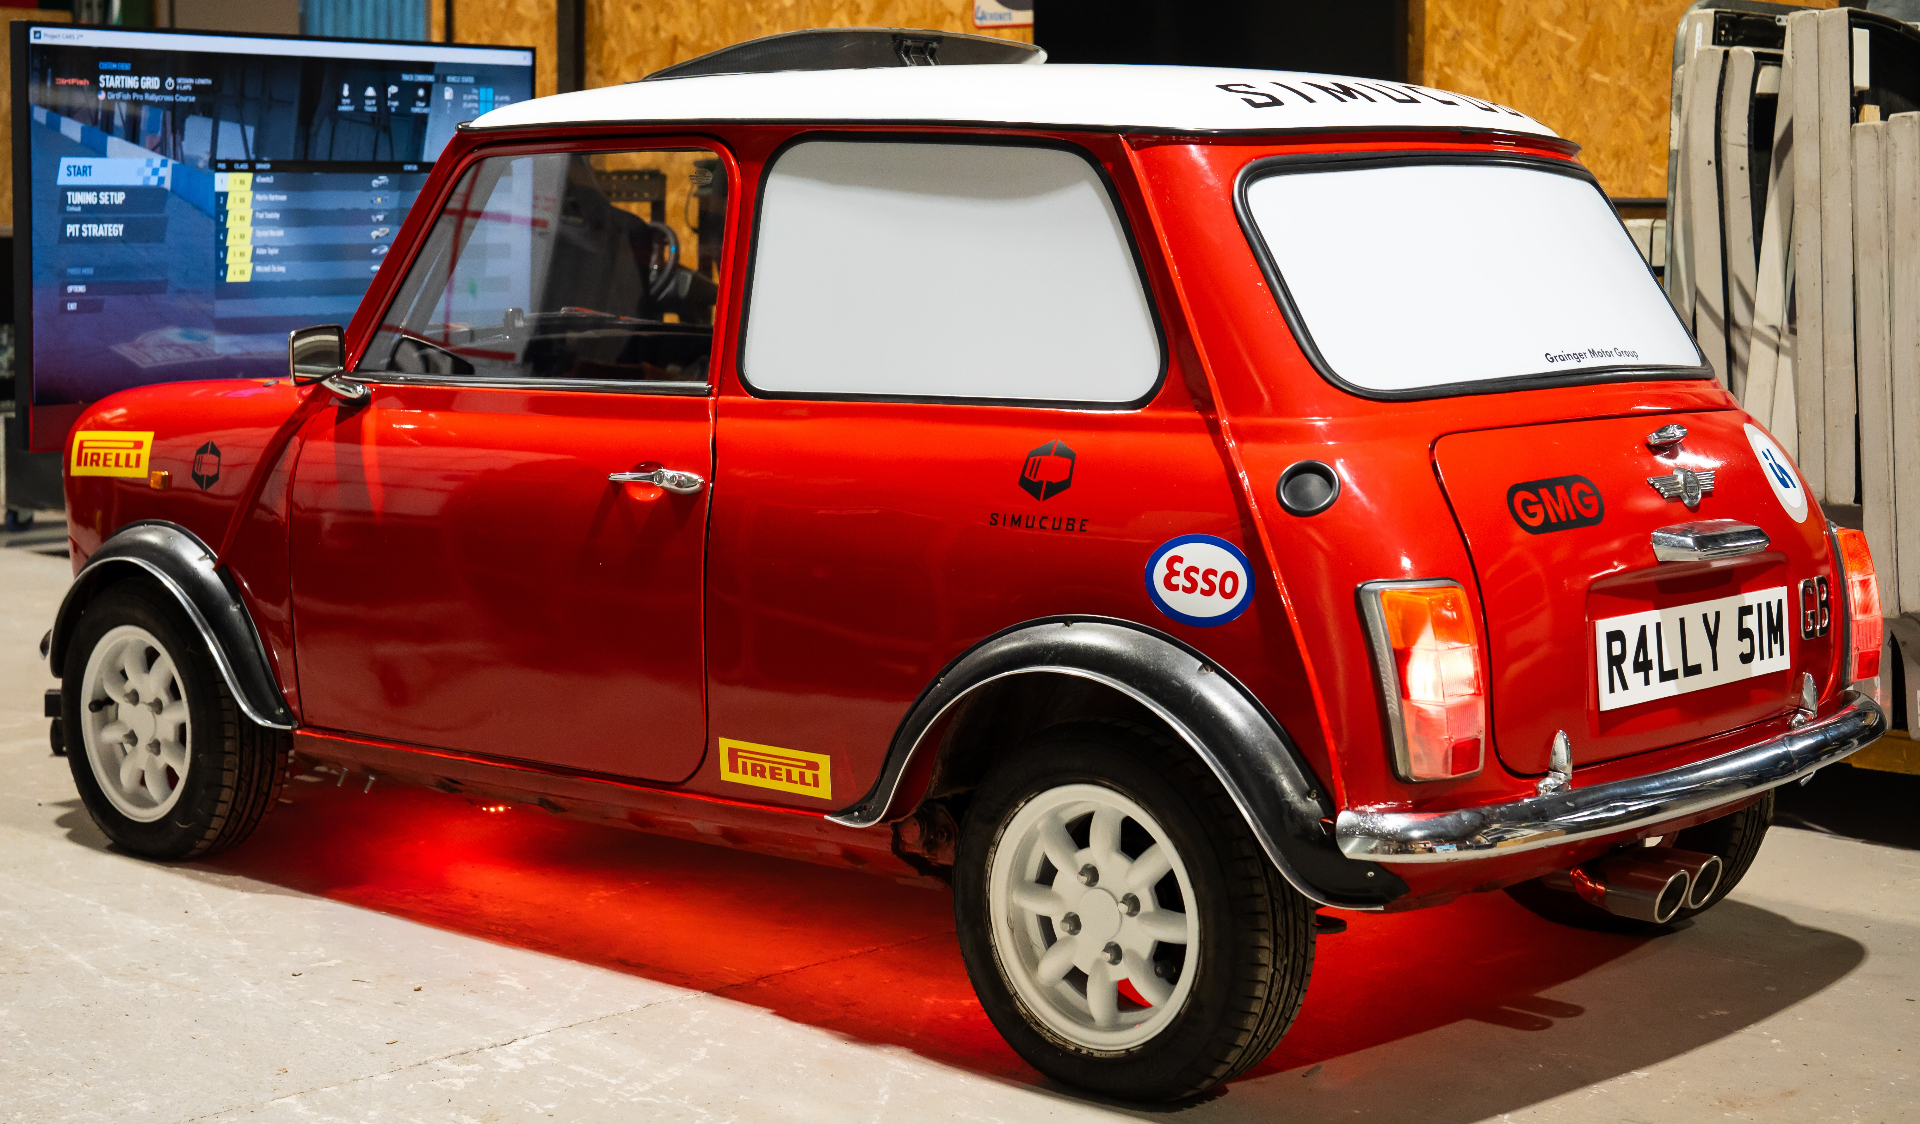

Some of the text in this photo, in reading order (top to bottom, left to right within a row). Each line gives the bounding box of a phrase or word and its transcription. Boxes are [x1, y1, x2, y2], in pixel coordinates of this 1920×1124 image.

[99, 74, 160, 90] STARTING GRID
[107, 91, 196, 102] DirtFish Pro Rallycross Course
[66, 165, 92, 177] START
[66, 191, 126, 205] TUNING SETUP
[66, 224, 124, 237] PIT STRATEGY
[1544, 347, 1639, 363] Grainger Motor Group
[76, 440, 144, 468] PIRELLI
[1513, 481, 1600, 527] GMG
[989, 512, 1089, 532] SIMUCUBE
[1798, 575, 1830, 641] GB
[1605, 610, 1721, 694] R4LLY
[728, 746, 820, 788] PIRELLI
